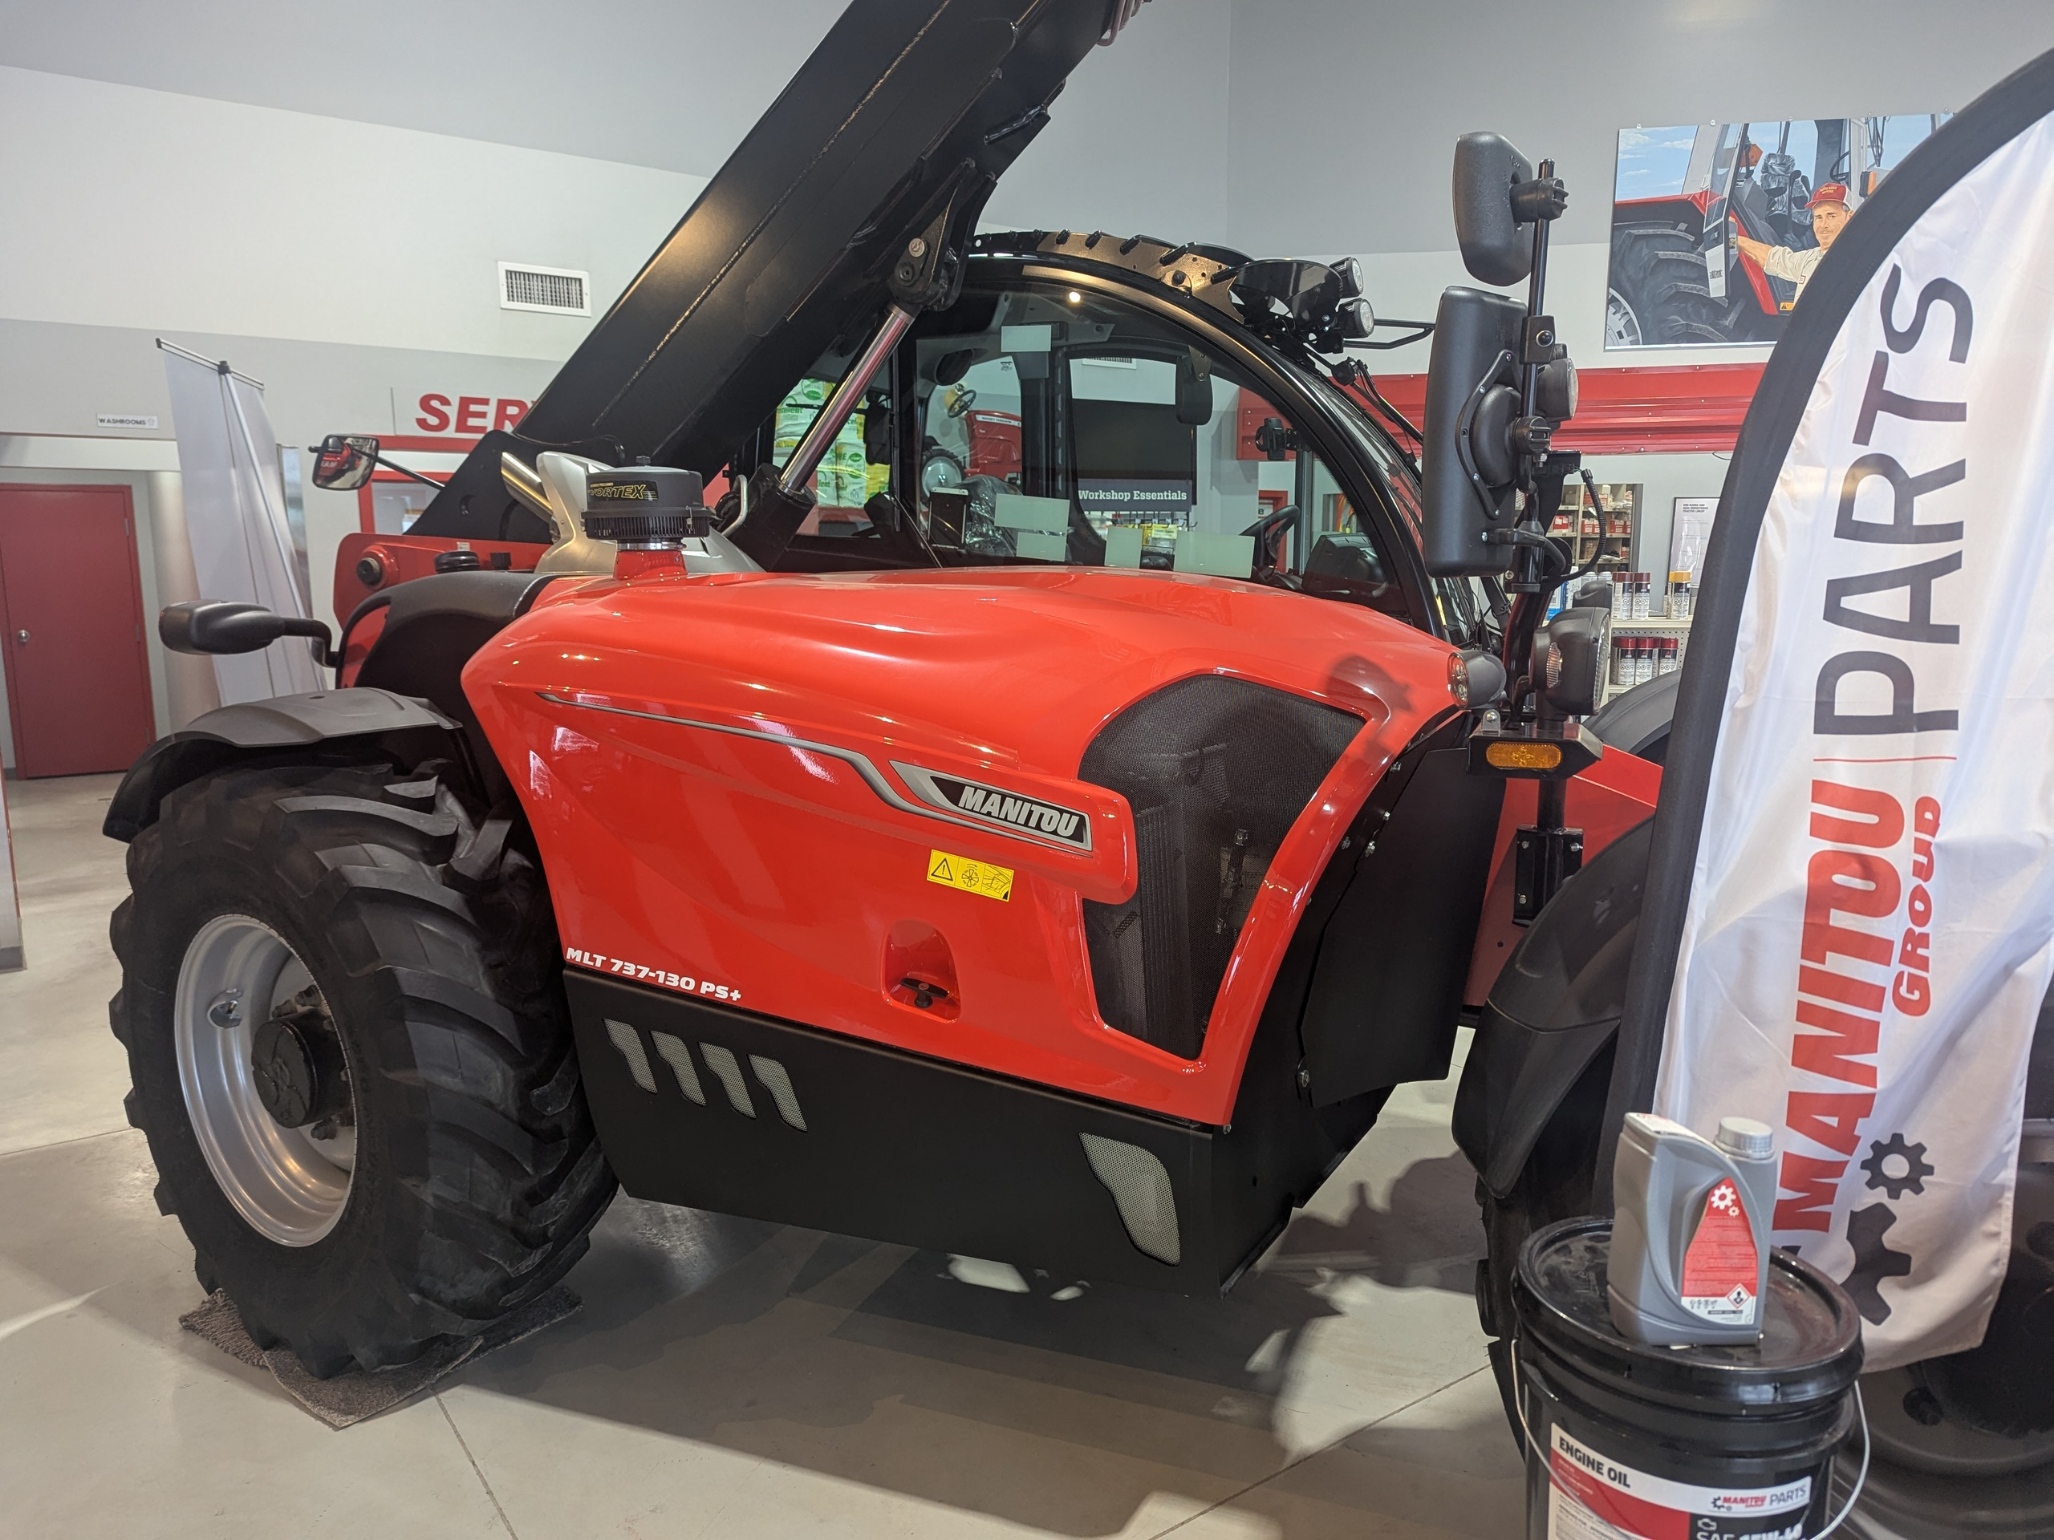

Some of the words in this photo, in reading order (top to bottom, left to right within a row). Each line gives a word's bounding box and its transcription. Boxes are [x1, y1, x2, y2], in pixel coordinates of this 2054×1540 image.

[98, 418, 146, 426] WASHROOMS
[415, 393, 540, 434] SER
[1078, 490, 1131, 502] Workshop
[1133, 490, 1187, 501] Essentials
[1813, 262, 1974, 735] PARTS
[958, 785, 1080, 837] MANITOU
[1891, 795, 1942, 1018] GROUP
[566, 947, 606, 968] MLT
[610, 958, 696, 991] 737-130
[700, 981, 742, 1002] PS+
[1771, 778, 1906, 1233] MANITOU
[1559, 1436, 1605, 1477] ENGINE
[1607, 1467, 1631, 1489] OIL
[1769, 1484, 1806, 1506] PARTS
